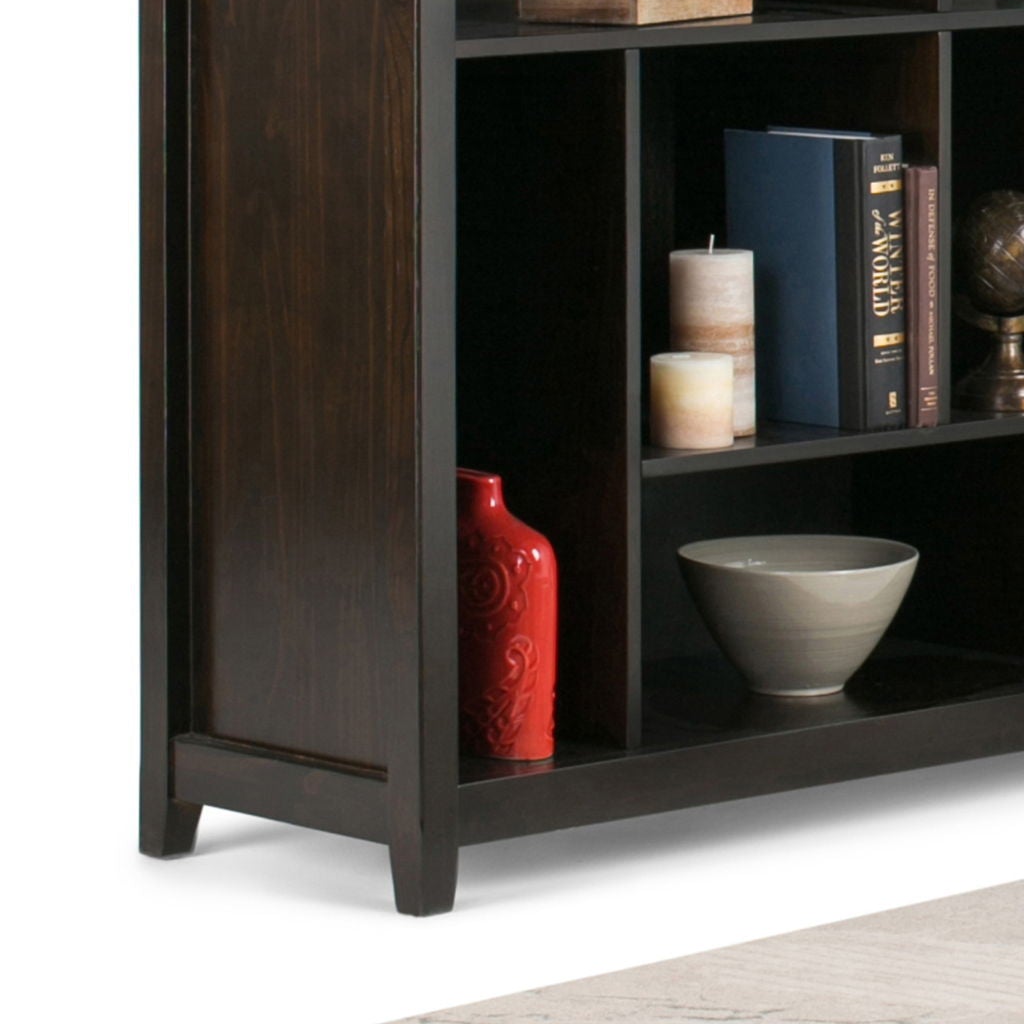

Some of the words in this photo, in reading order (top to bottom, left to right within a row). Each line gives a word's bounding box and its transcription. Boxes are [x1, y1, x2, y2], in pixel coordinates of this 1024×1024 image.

[928, 188, 937, 201] IN
[927, 204, 937, 251] DEFENSE
[872, 235, 890, 317] WORLD
[888, 209, 904, 314] WINTER
[928, 265, 937, 298] FOOD
